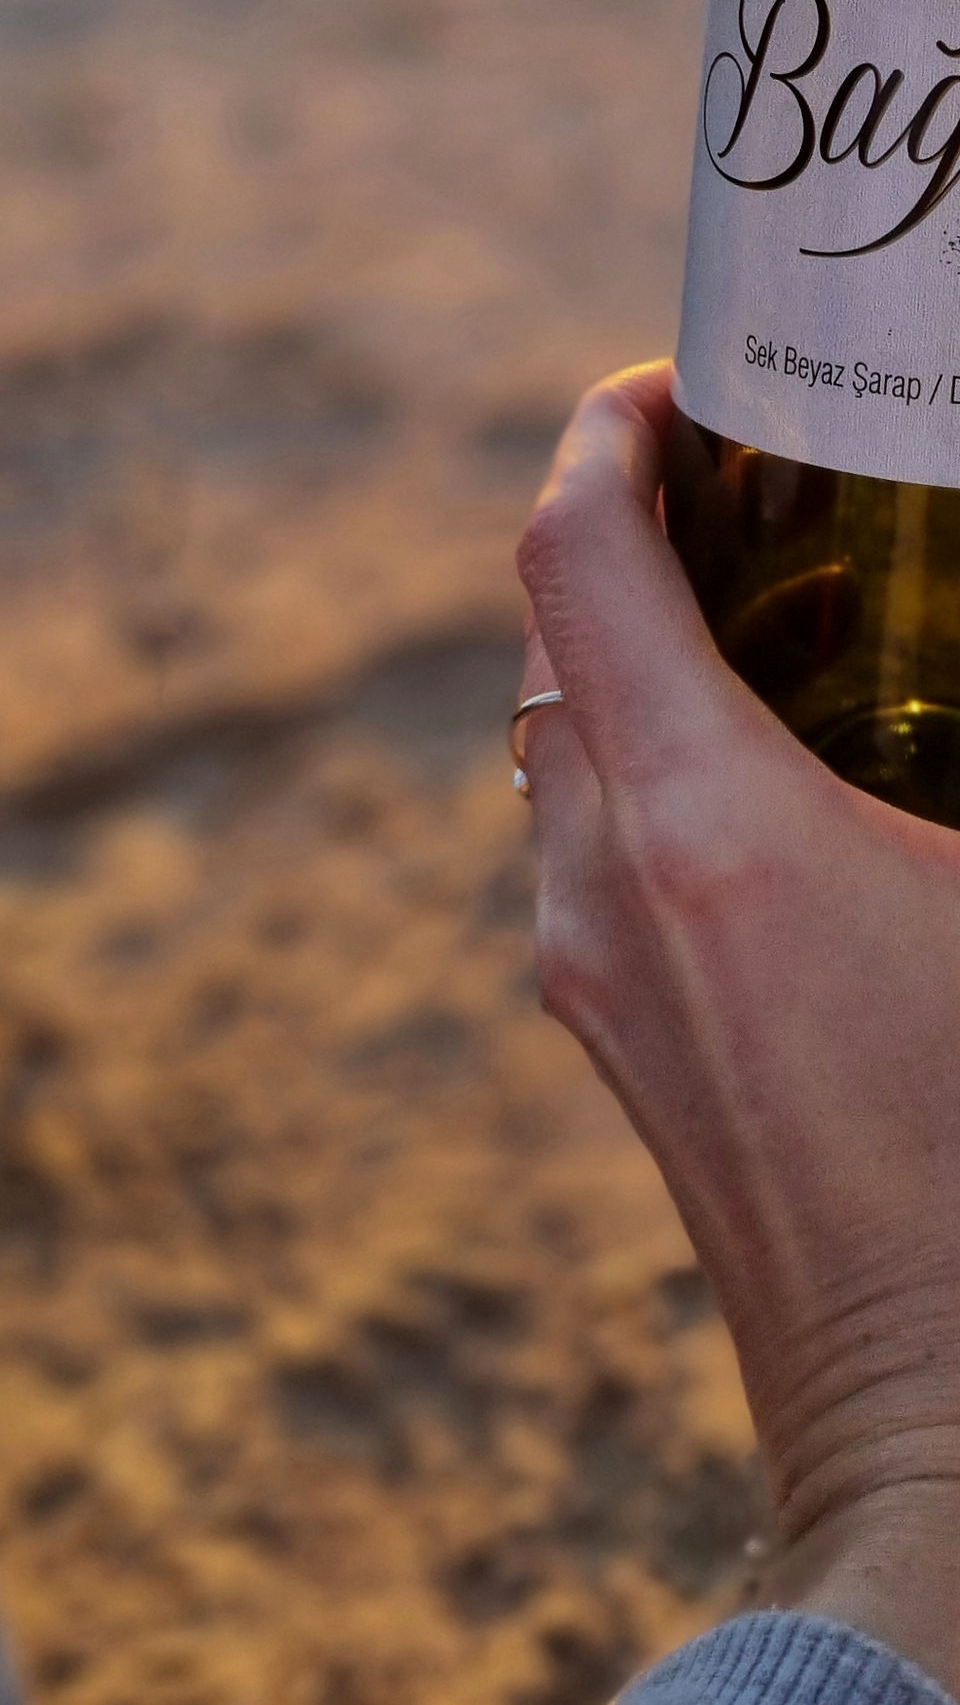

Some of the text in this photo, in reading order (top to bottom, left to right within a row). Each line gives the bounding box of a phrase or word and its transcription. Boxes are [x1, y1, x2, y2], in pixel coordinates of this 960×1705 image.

[745, 334, 777, 371] Sek
[784, 346, 845, 388] Beyaz
[852, 361, 921, 406] Şarap
[928, 373, 943, 406] /
